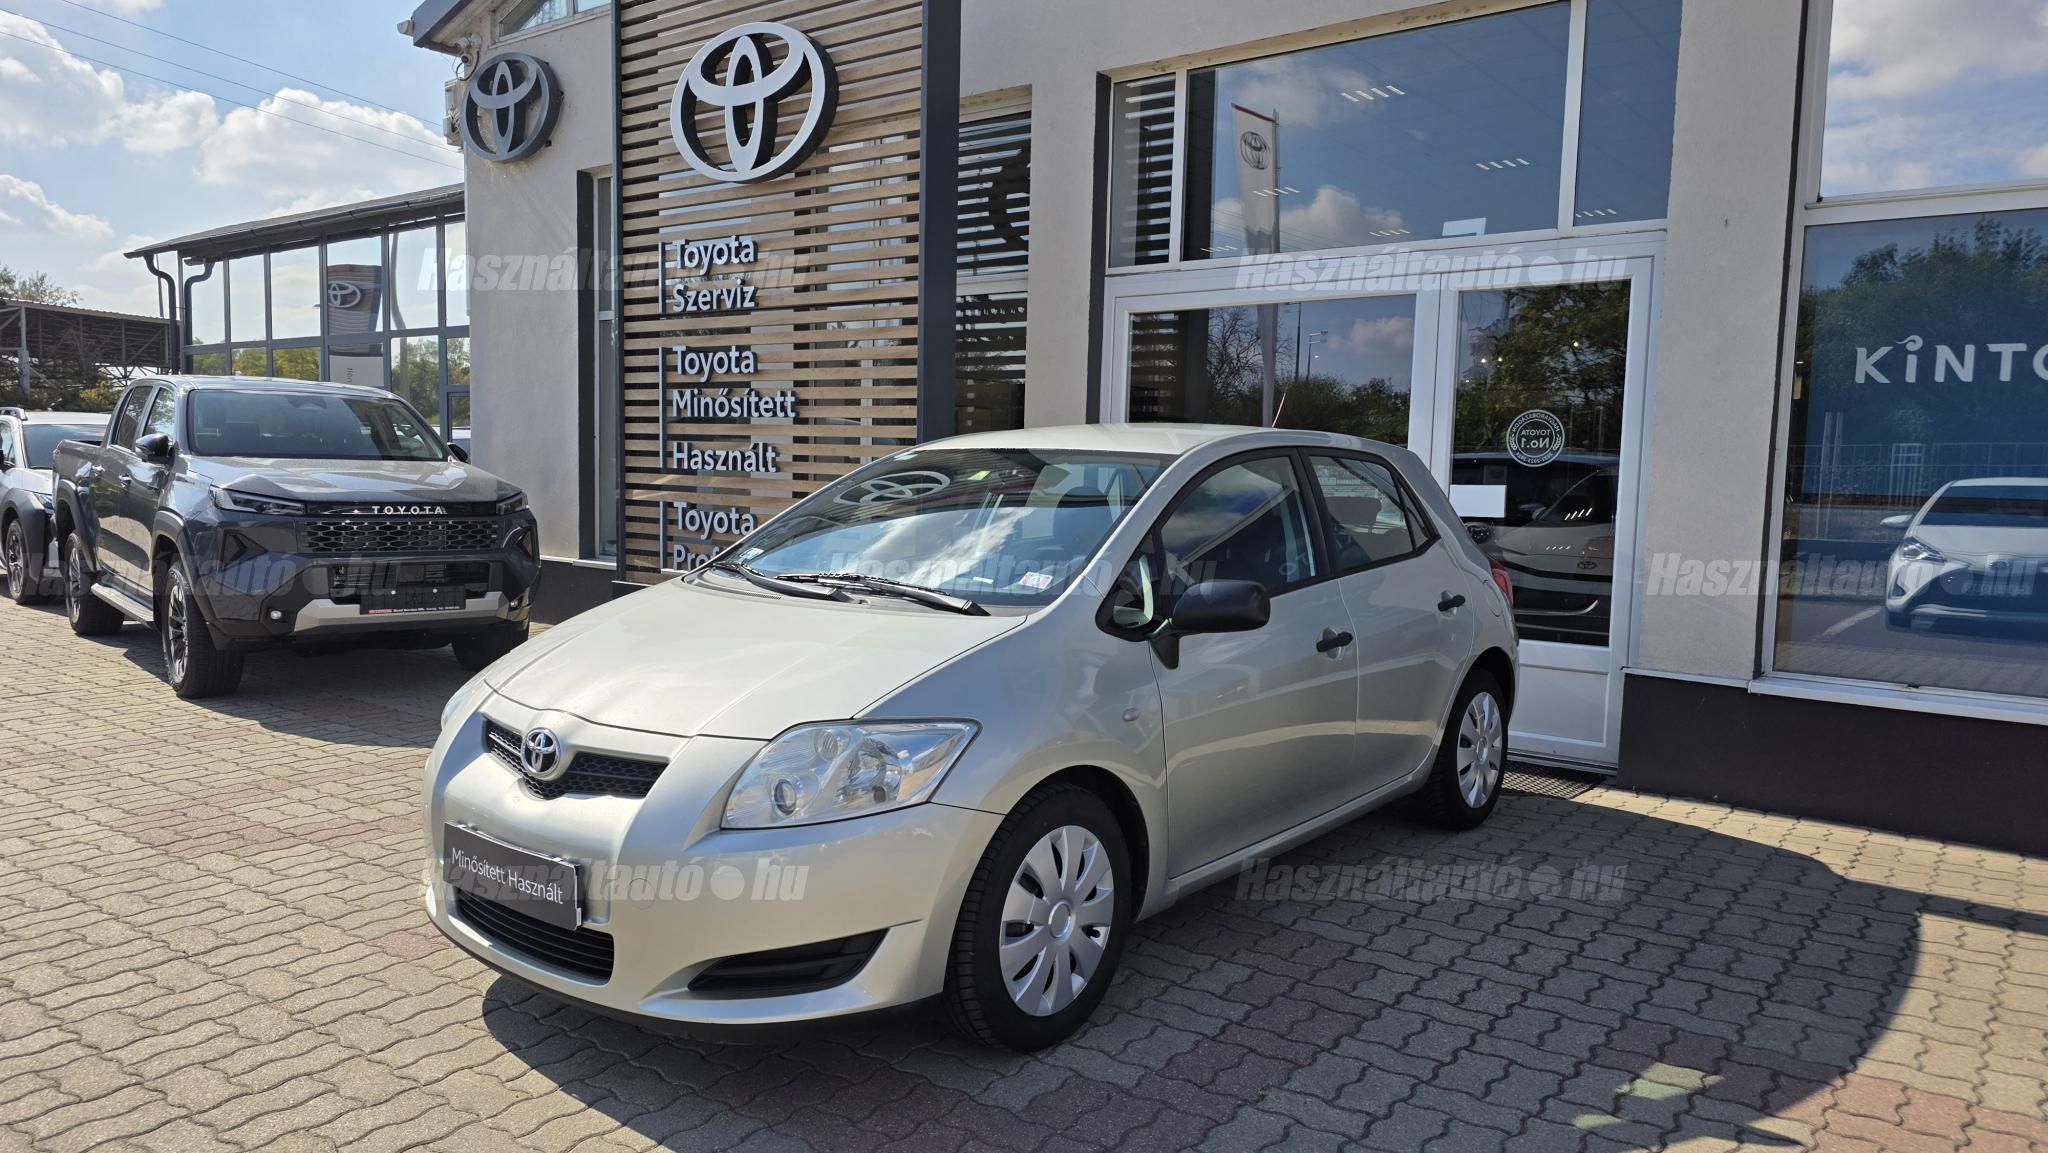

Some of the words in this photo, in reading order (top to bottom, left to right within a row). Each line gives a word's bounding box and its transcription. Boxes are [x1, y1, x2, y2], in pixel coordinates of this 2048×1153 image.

[672, 235, 755, 275] Toyota
[672, 278, 756, 312] Szerviz
[672, 345, 755, 383] Toyota
[672, 387, 796, 418] Minősített
[672, 440, 777, 472] Használt
[371, 505, 444, 515] TOYOTA
[673, 501, 754, 540] Toyota
[452, 847, 506, 885] Minősített
[508, 869, 564, 905] Használt
